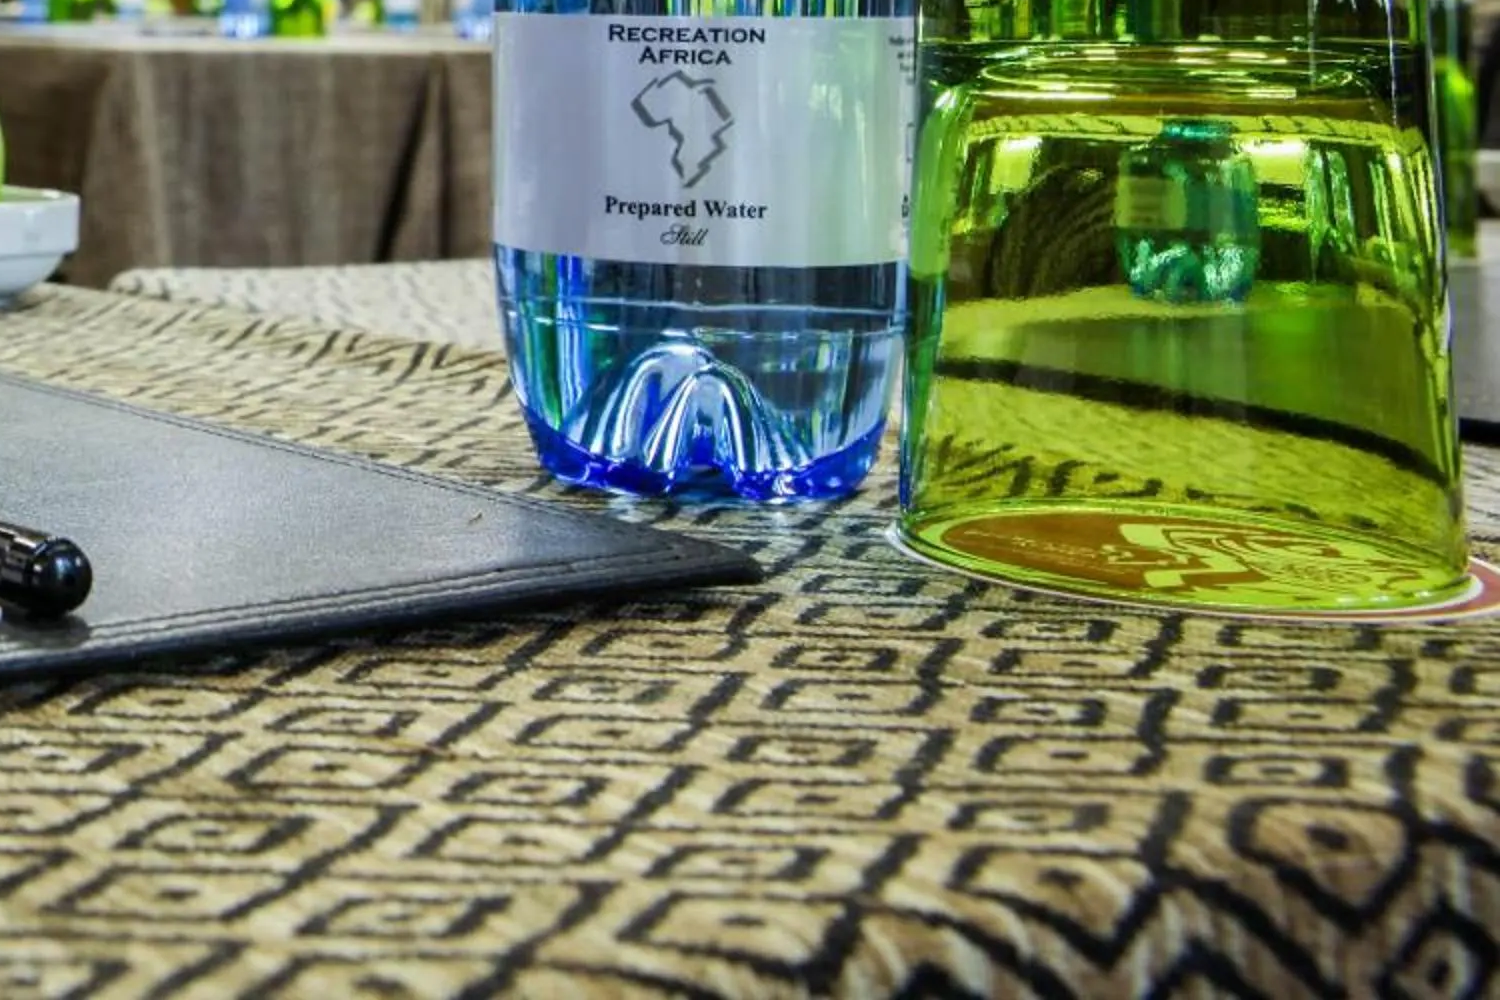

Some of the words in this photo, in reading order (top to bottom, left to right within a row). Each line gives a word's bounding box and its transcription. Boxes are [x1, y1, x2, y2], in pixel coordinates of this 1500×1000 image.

[608, 23, 766, 44] RECREATION
[638, 45, 732, 65] AFRICA
[604, 194, 697, 221] Prepared
[702, 199, 769, 219] Water
[659, 223, 709, 246] Still
